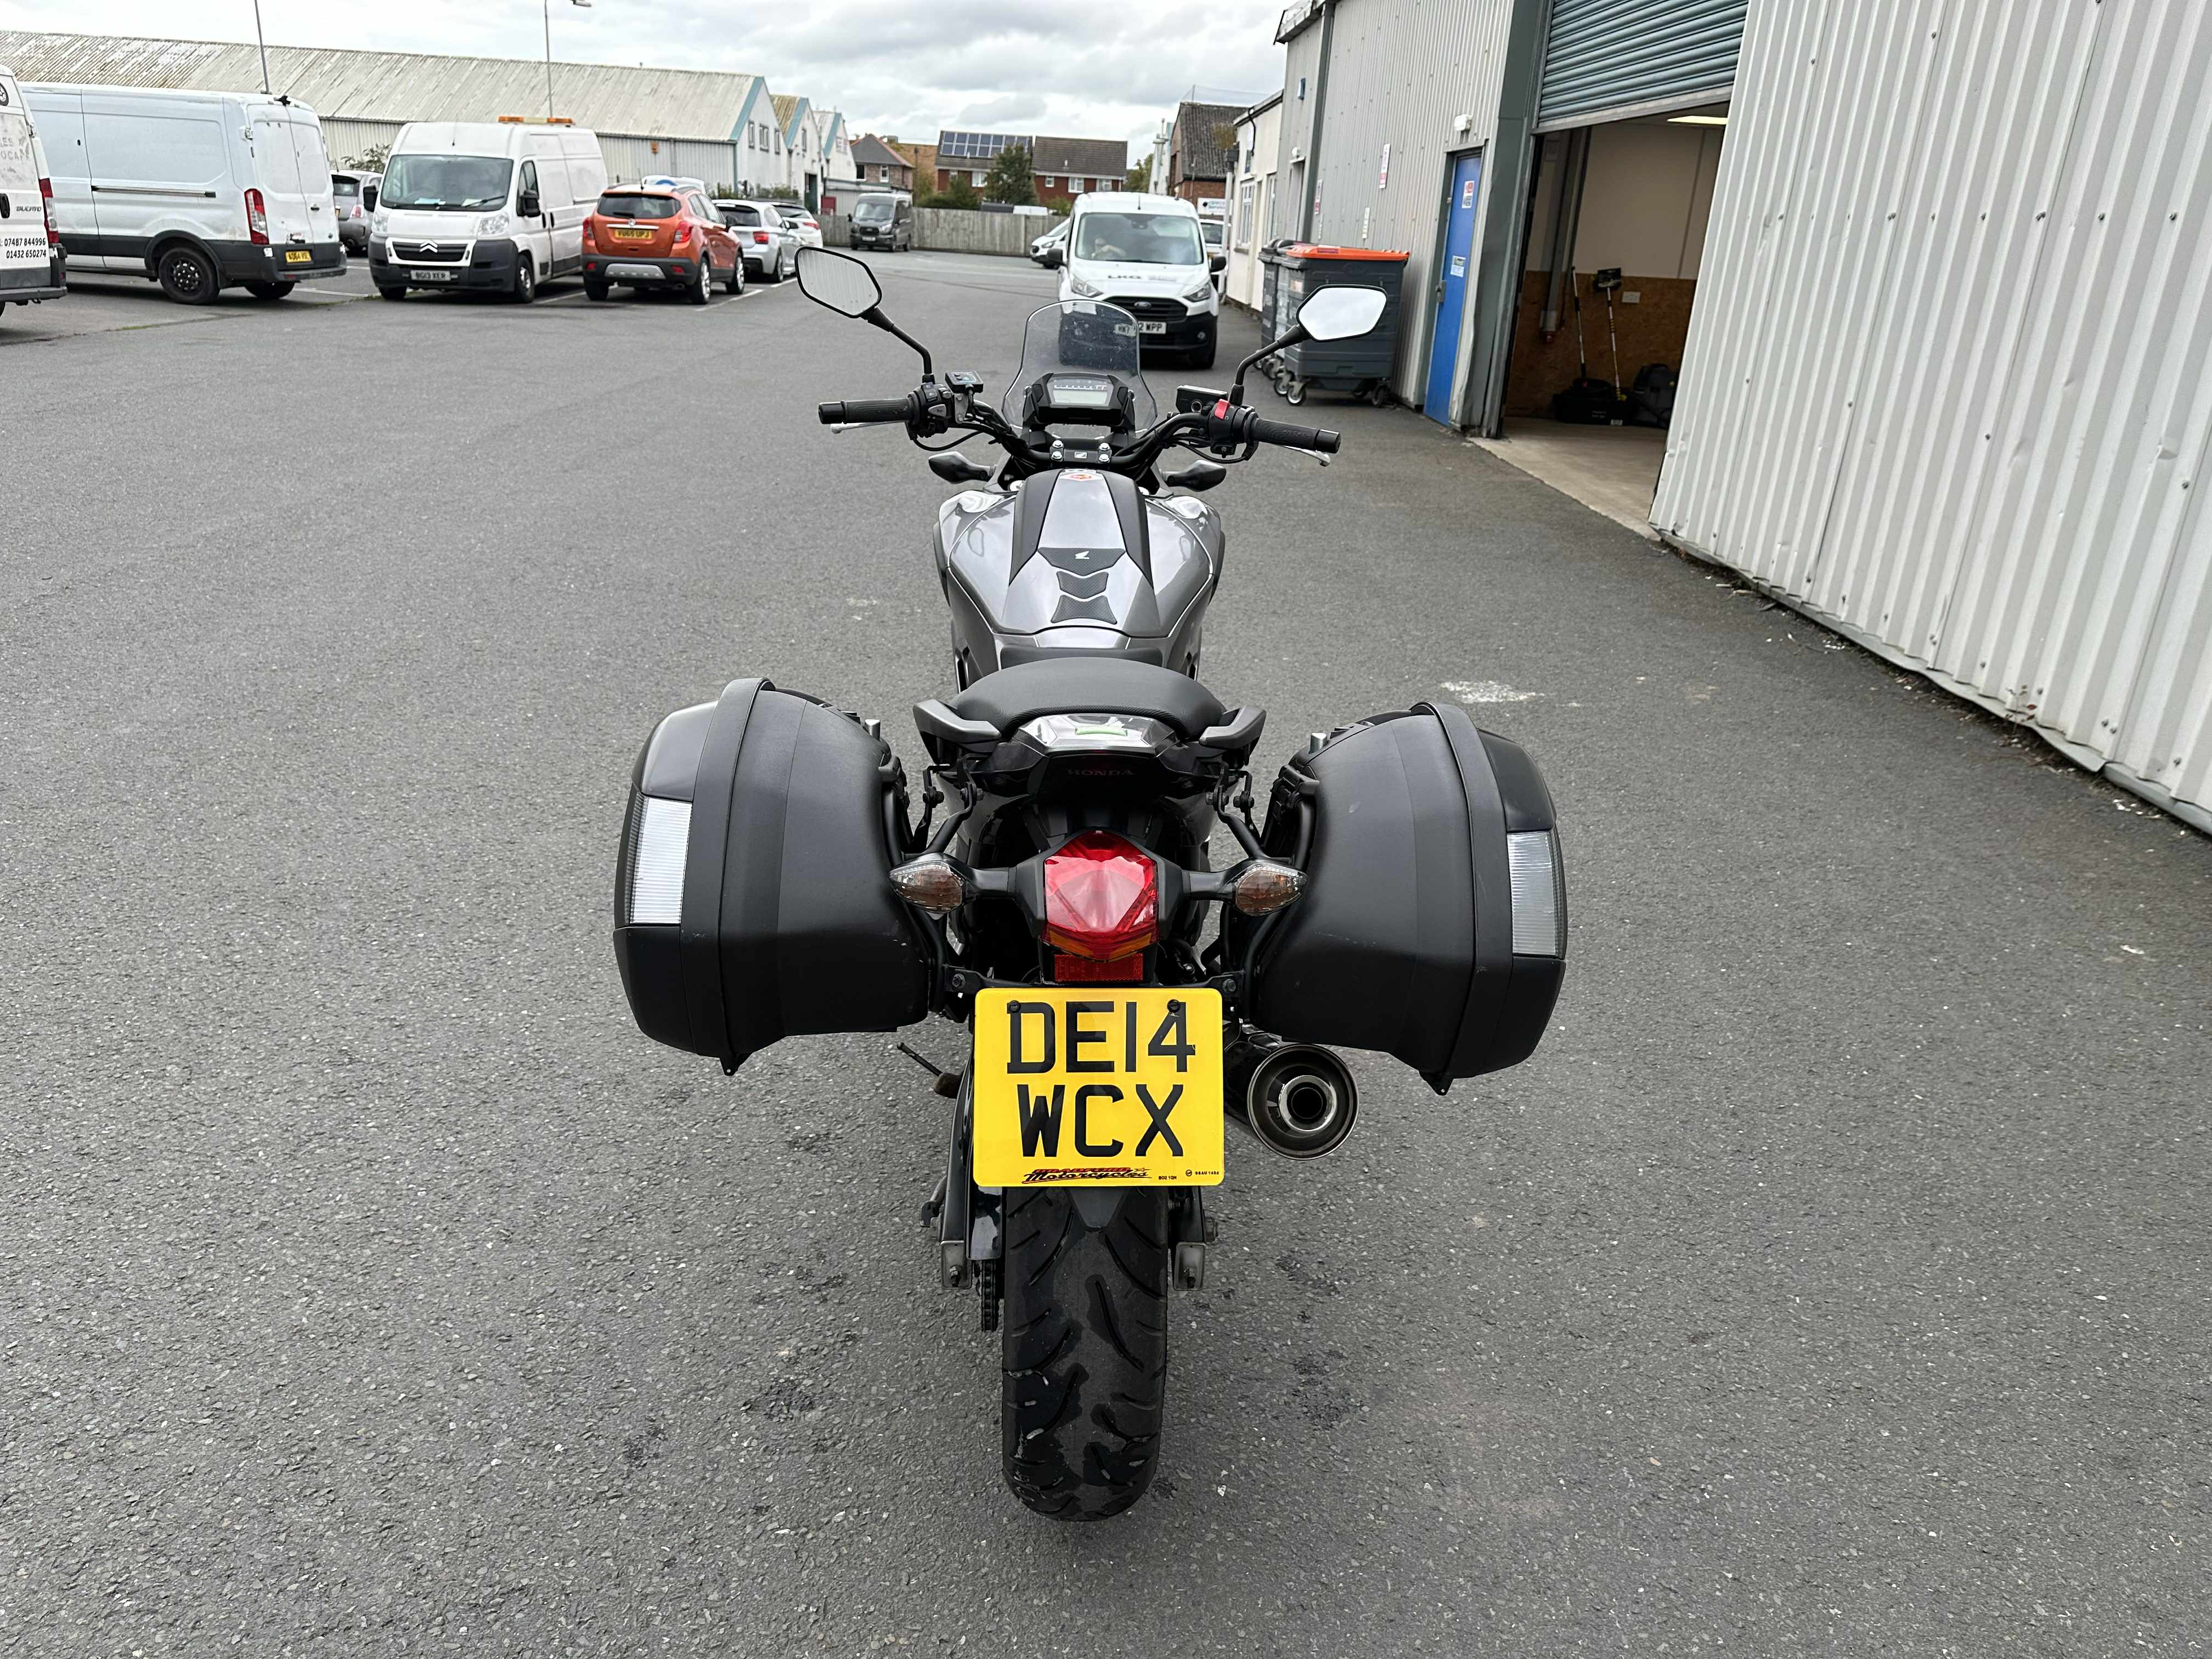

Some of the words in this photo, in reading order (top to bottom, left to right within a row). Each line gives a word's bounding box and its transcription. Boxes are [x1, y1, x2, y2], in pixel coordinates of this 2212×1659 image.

[4, 238, 22, 246] 07487
[24, 238, 46, 246] 844996
[6, 250, 24, 258] 01432
[25, 250, 46, 258] 650274
[1007, 1001, 1196, 1074] DE14
[1017, 1084, 1183, 1158] WCX
[1024, 1169, 1148, 1181] Motorcycles
